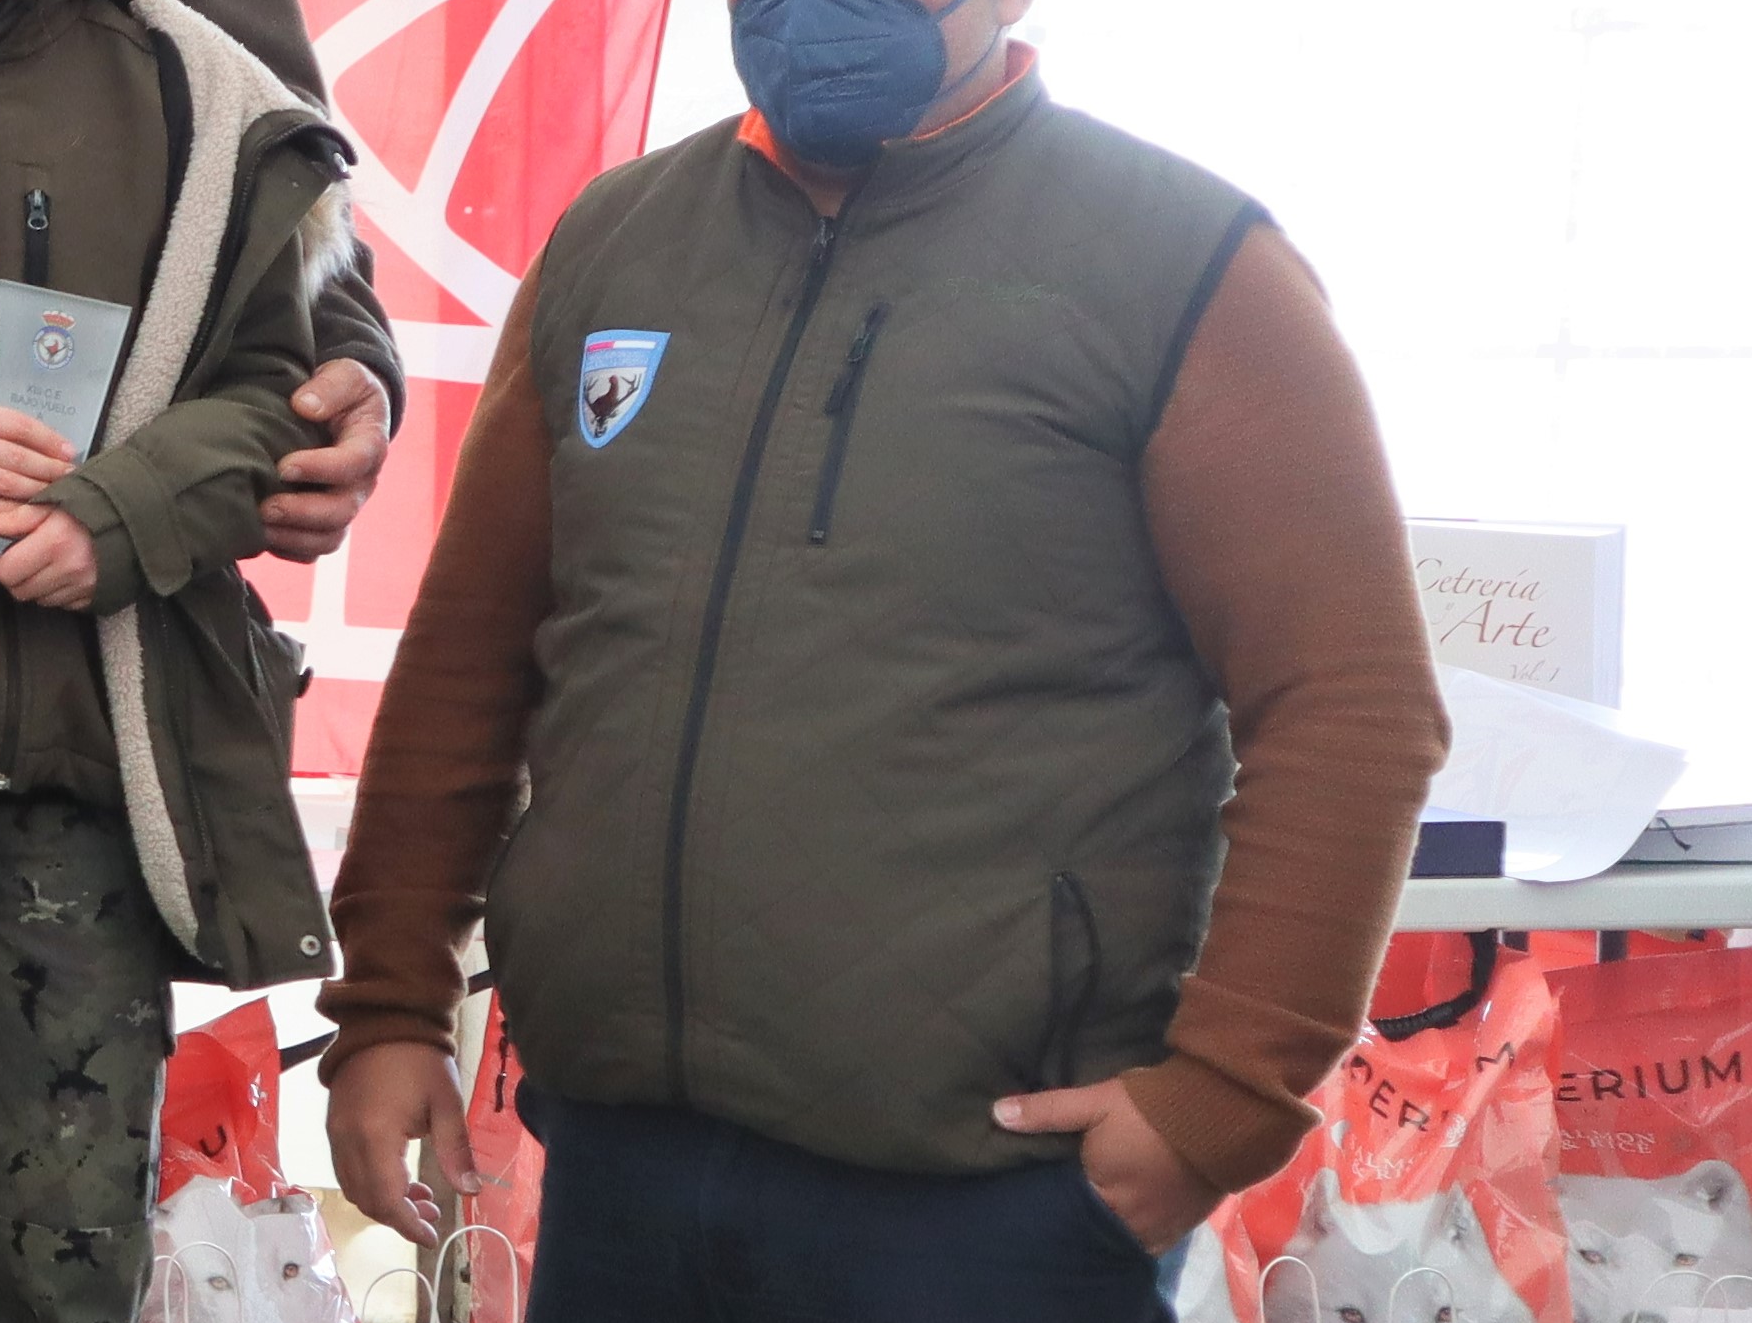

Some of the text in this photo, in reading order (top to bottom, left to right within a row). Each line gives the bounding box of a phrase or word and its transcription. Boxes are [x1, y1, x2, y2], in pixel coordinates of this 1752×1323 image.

[1440, 599, 1557, 648] Arte
[1557, 1051, 1742, 1102] ERIUM
[1561, 1130, 1656, 1145] ALMON
